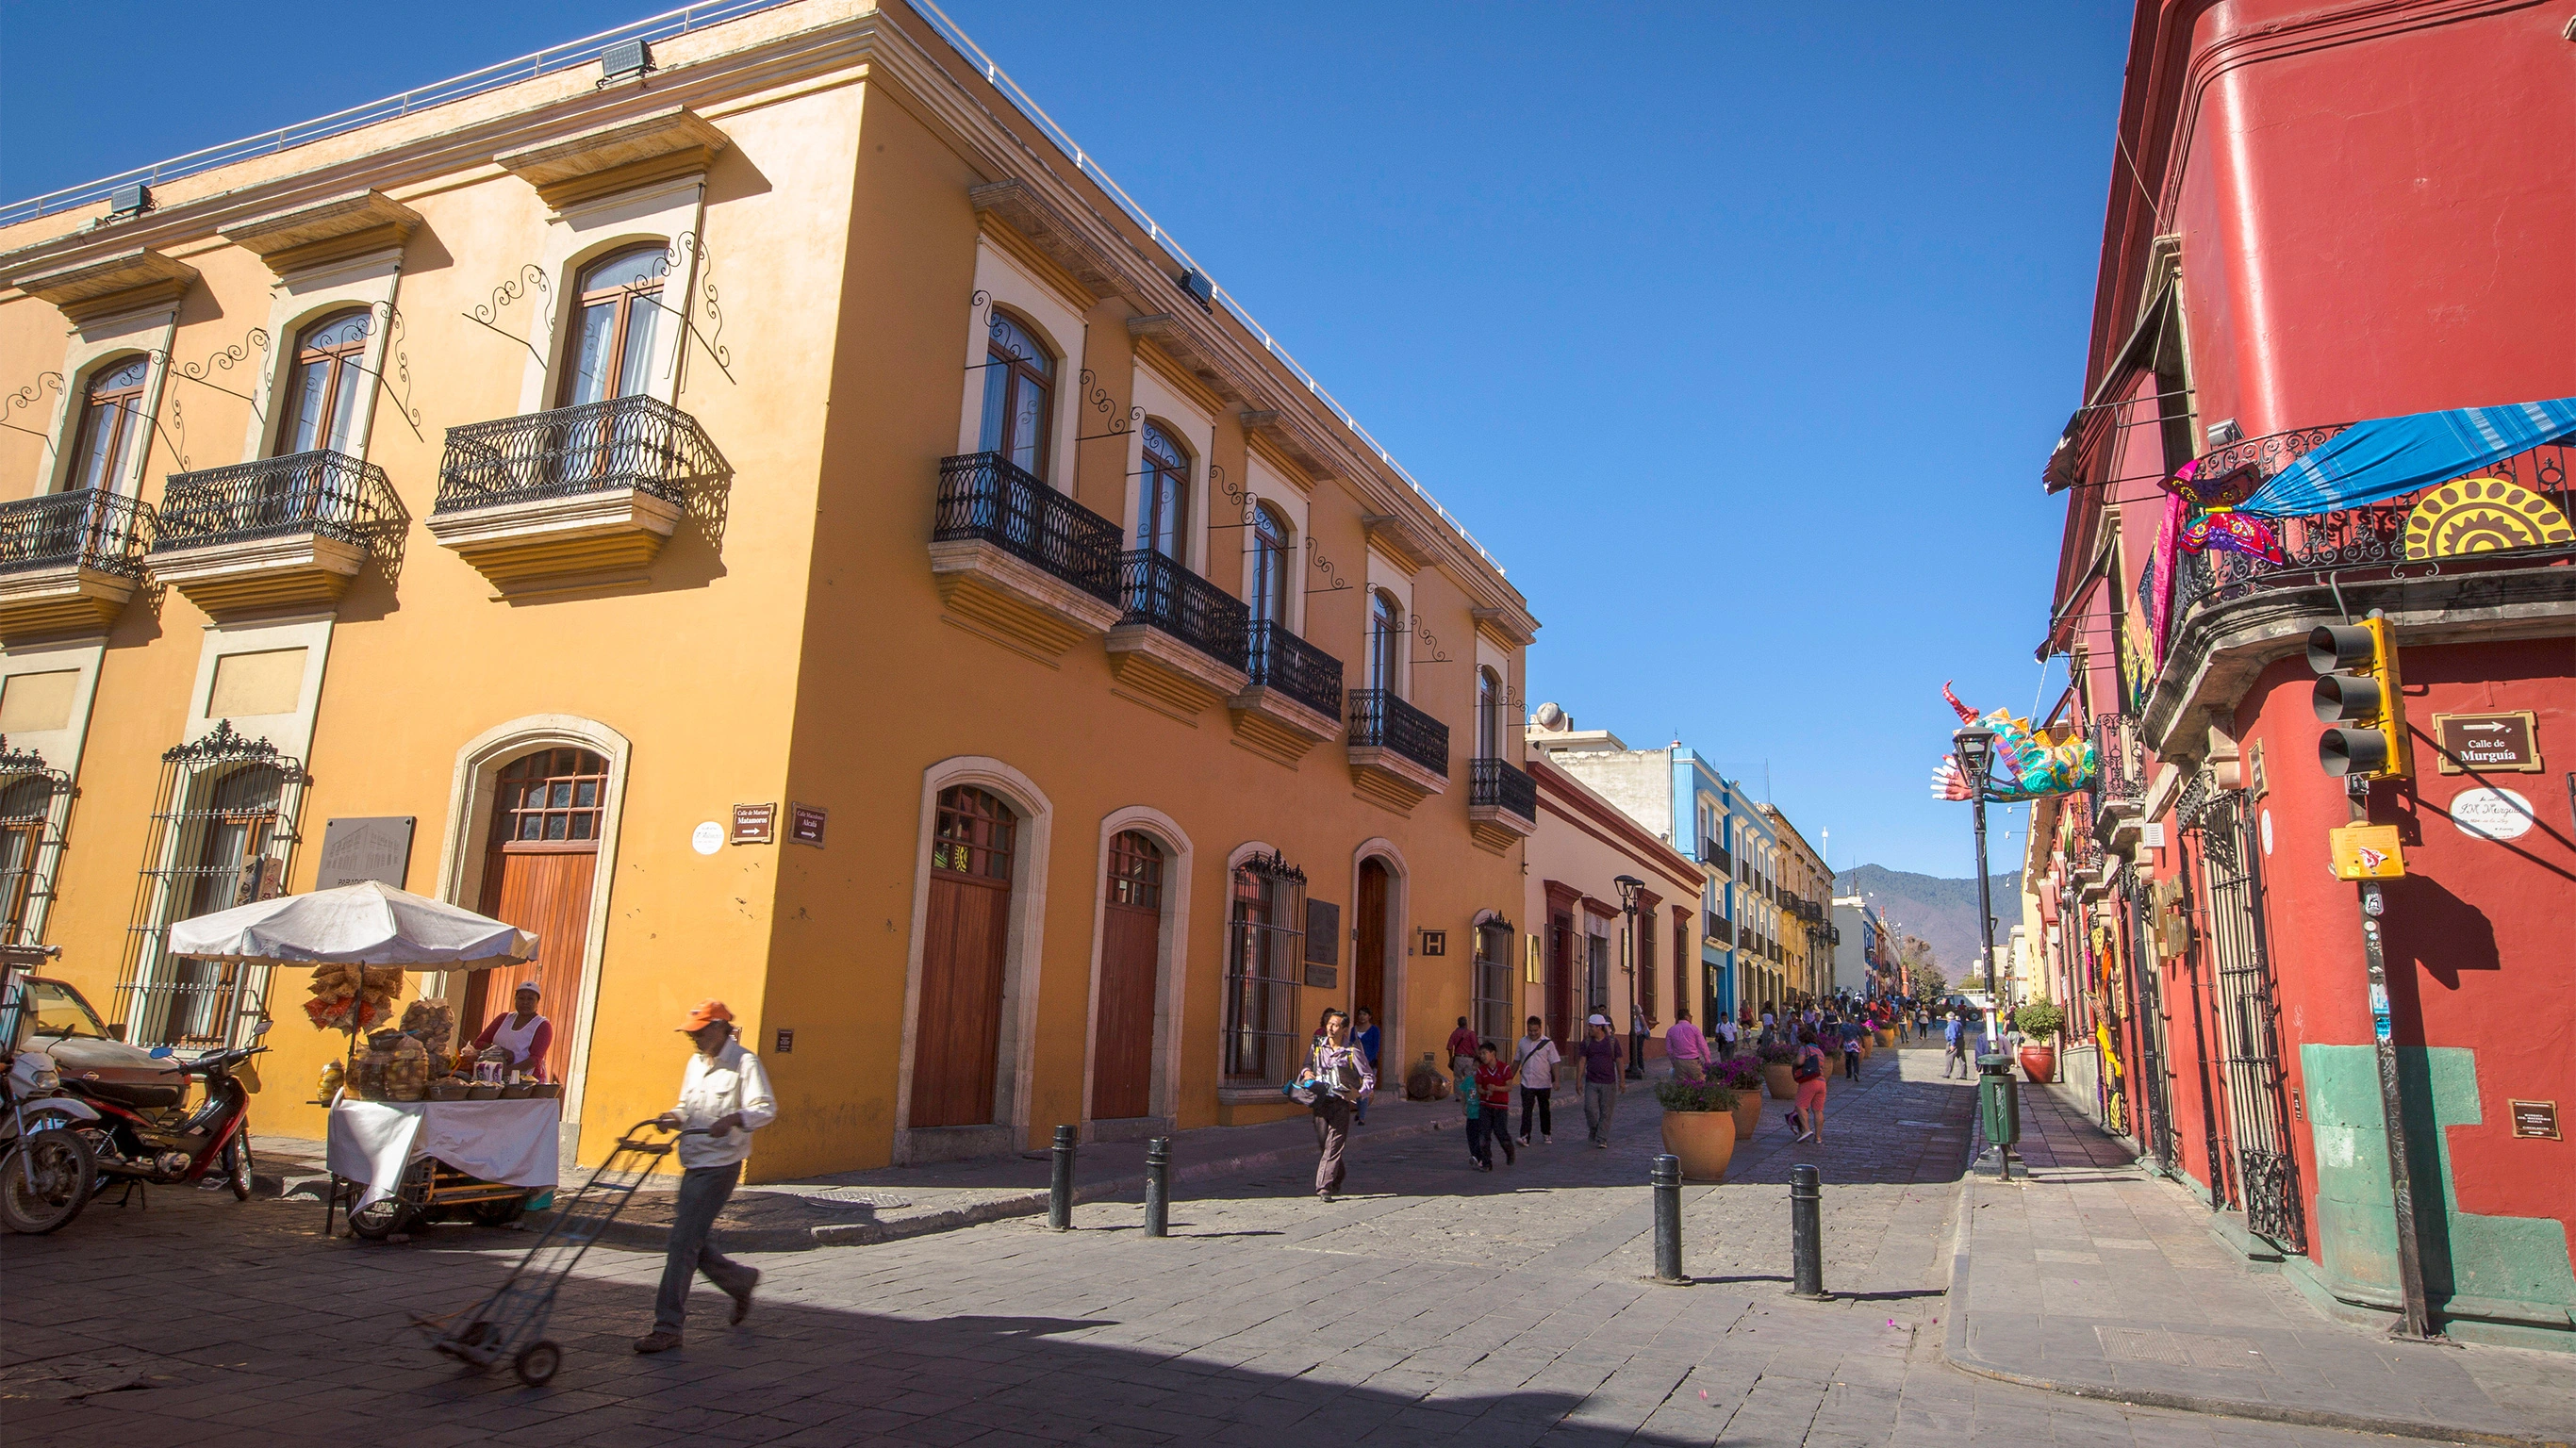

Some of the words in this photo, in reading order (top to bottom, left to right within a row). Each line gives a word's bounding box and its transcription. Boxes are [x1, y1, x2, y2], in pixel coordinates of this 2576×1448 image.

[2468, 739, 2492, 749] Calle
[2493, 739, 2505, 748] de
[2460, 749, 2517, 763] Murguía
[1427, 934, 1442, 953] H
